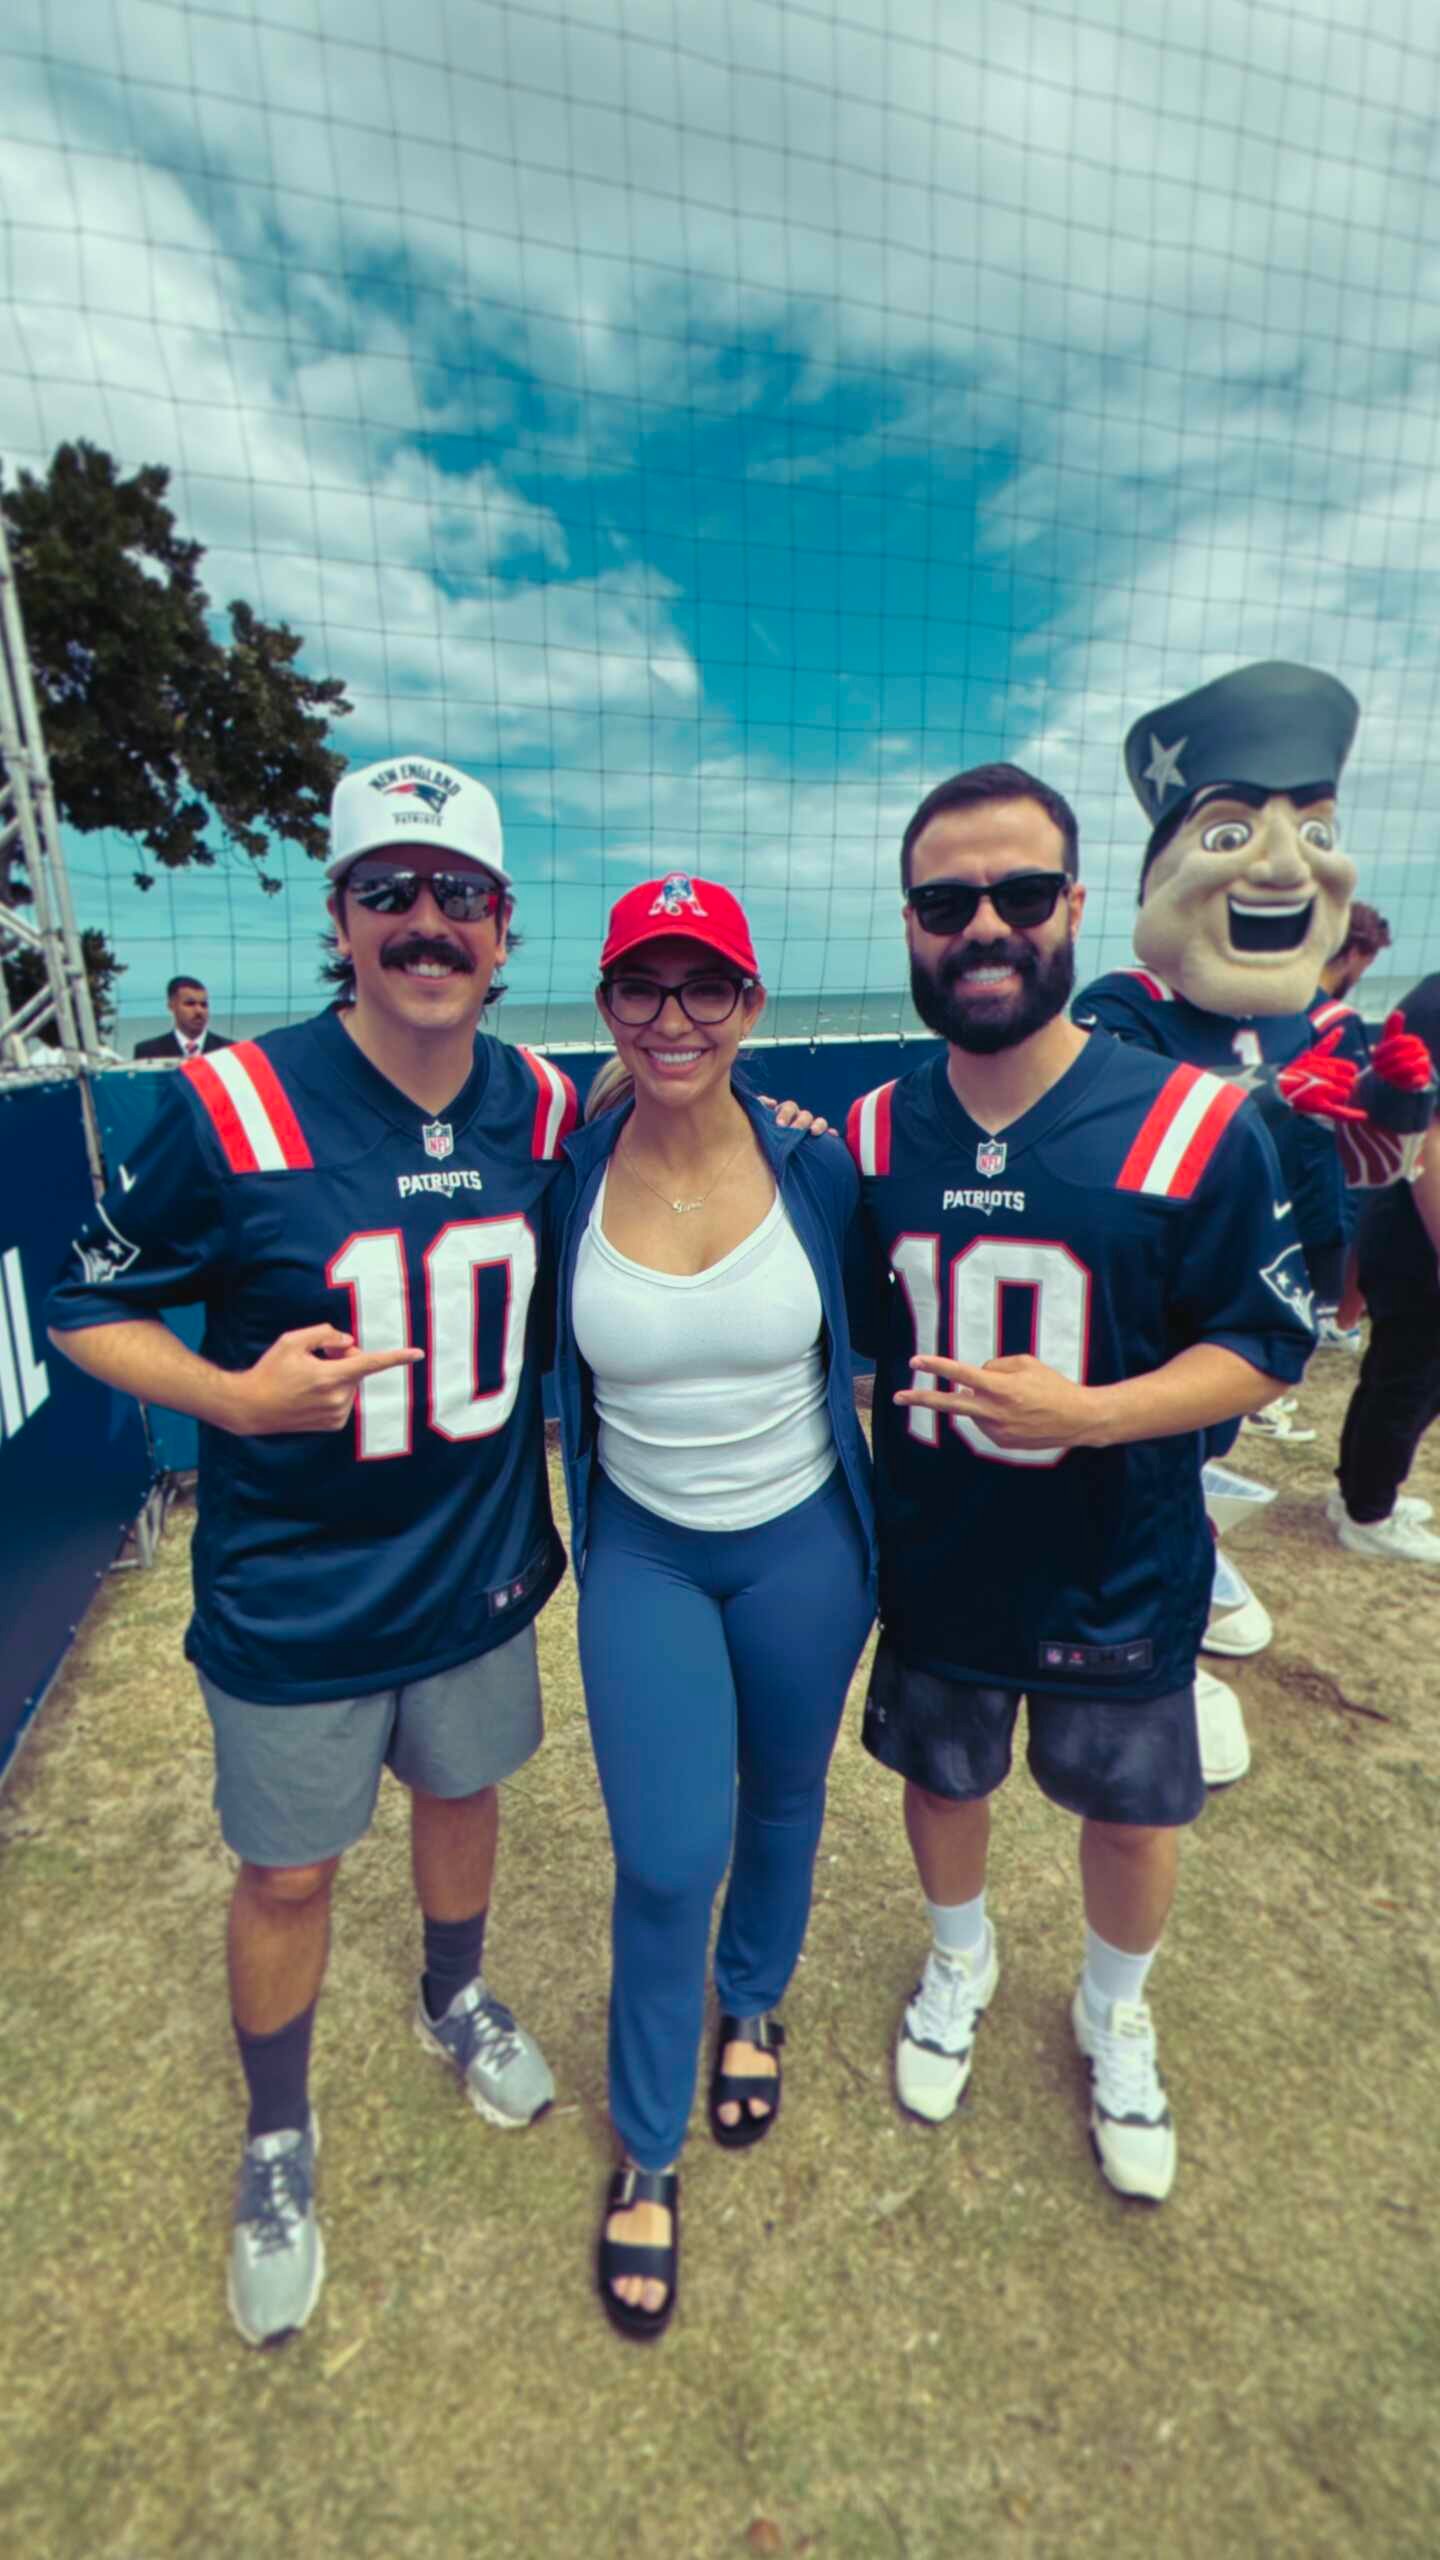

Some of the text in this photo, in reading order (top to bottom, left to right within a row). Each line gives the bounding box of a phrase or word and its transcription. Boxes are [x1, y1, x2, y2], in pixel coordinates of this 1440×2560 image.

[370, 764, 461, 796] NEW ENGLAND
[397, 1170, 482, 1199] PATRIOTS
[942, 1189, 1025, 1213] PATRIOTS
[325, 1213, 536, 1461] 10
[890, 1232, 1092, 1468] 10
